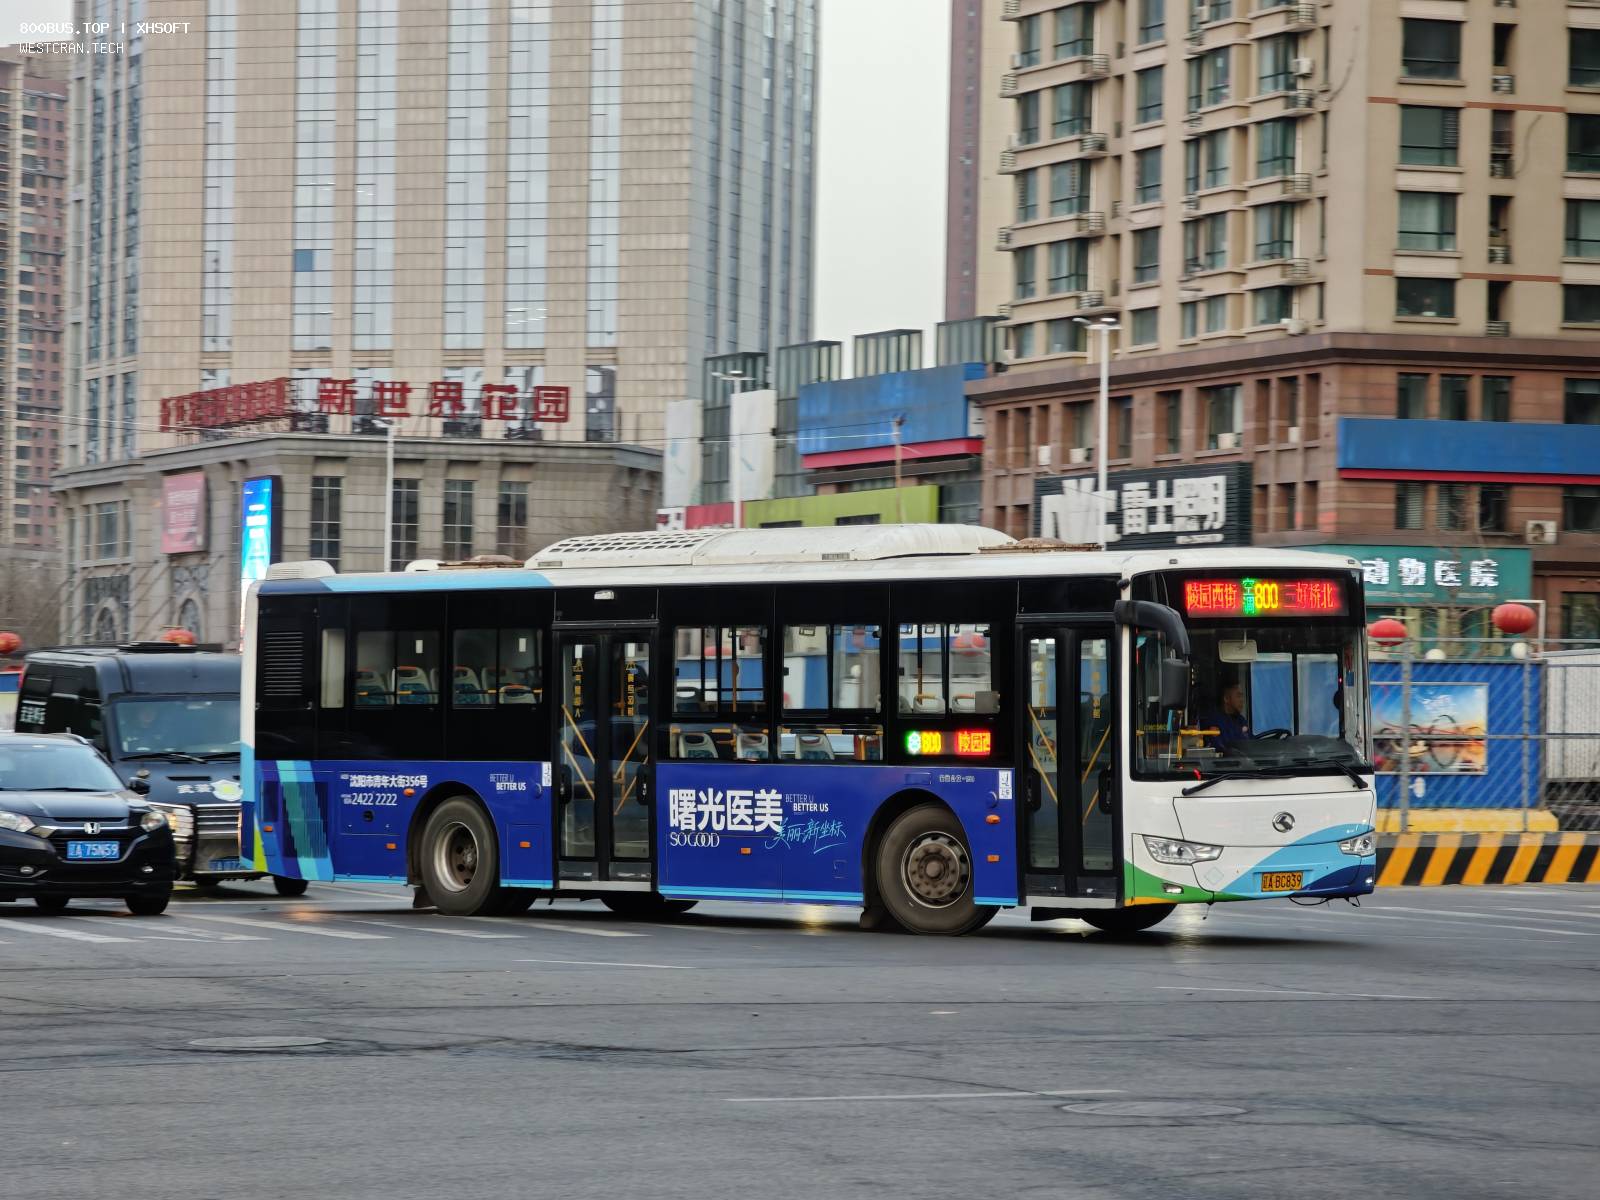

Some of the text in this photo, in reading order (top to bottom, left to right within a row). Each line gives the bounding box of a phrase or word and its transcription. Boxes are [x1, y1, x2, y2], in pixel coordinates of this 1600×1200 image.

[318, 378, 570, 423] 新世界花园
[1186, 583, 1238, 609] 陵园西街
[1255, 582, 1279, 609] 800
[1283, 582, 1335, 609] 三好桥北
[496, 782, 527, 791] BETTER US
[351, 793, 374, 806] 2422
[375, 793, 398, 806] 2222
[785, 793, 808, 803] BETTER
[669, 787, 783, 833] 曙光医美
[793, 802, 829, 812] BETTER US
